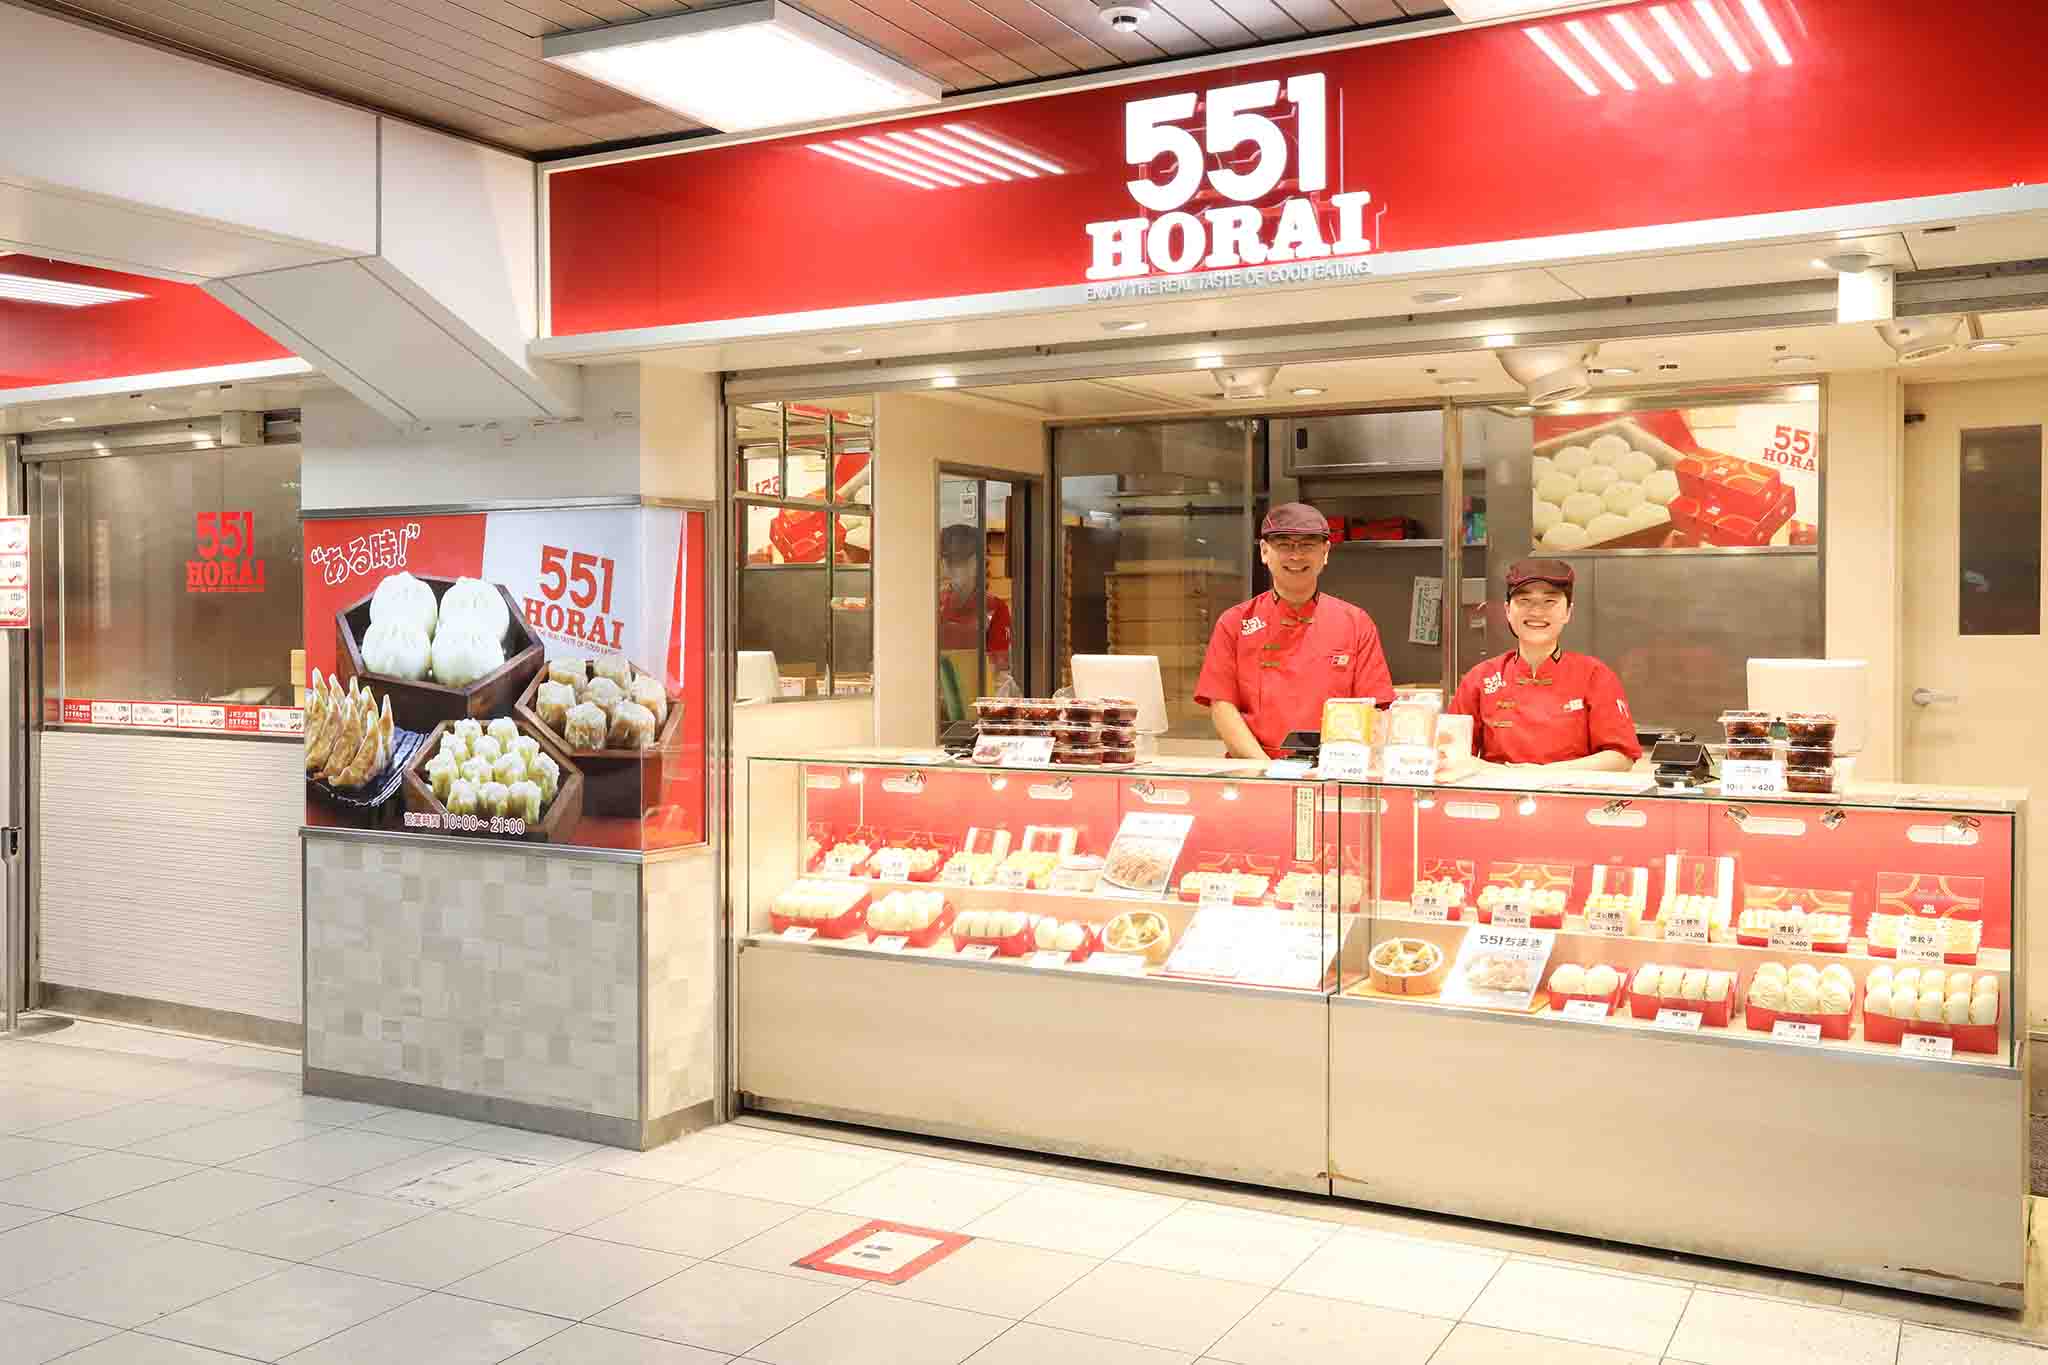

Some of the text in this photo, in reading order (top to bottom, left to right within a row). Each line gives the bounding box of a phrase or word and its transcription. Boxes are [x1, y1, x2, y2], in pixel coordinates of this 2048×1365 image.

[1126, 72, 1326, 211] 551
[1085, 191, 1371, 280] HORAI
[1200, 270, 1240, 290] TASTE
[1245, 269, 1264, 285] OF
[1763, 448, 1815, 471] HORA
[196, 511, 254, 559] 551
[186, 560, 265, 585] HORAI
[540, 544, 614, 614] 551
[523, 597, 624, 649] HORAI
